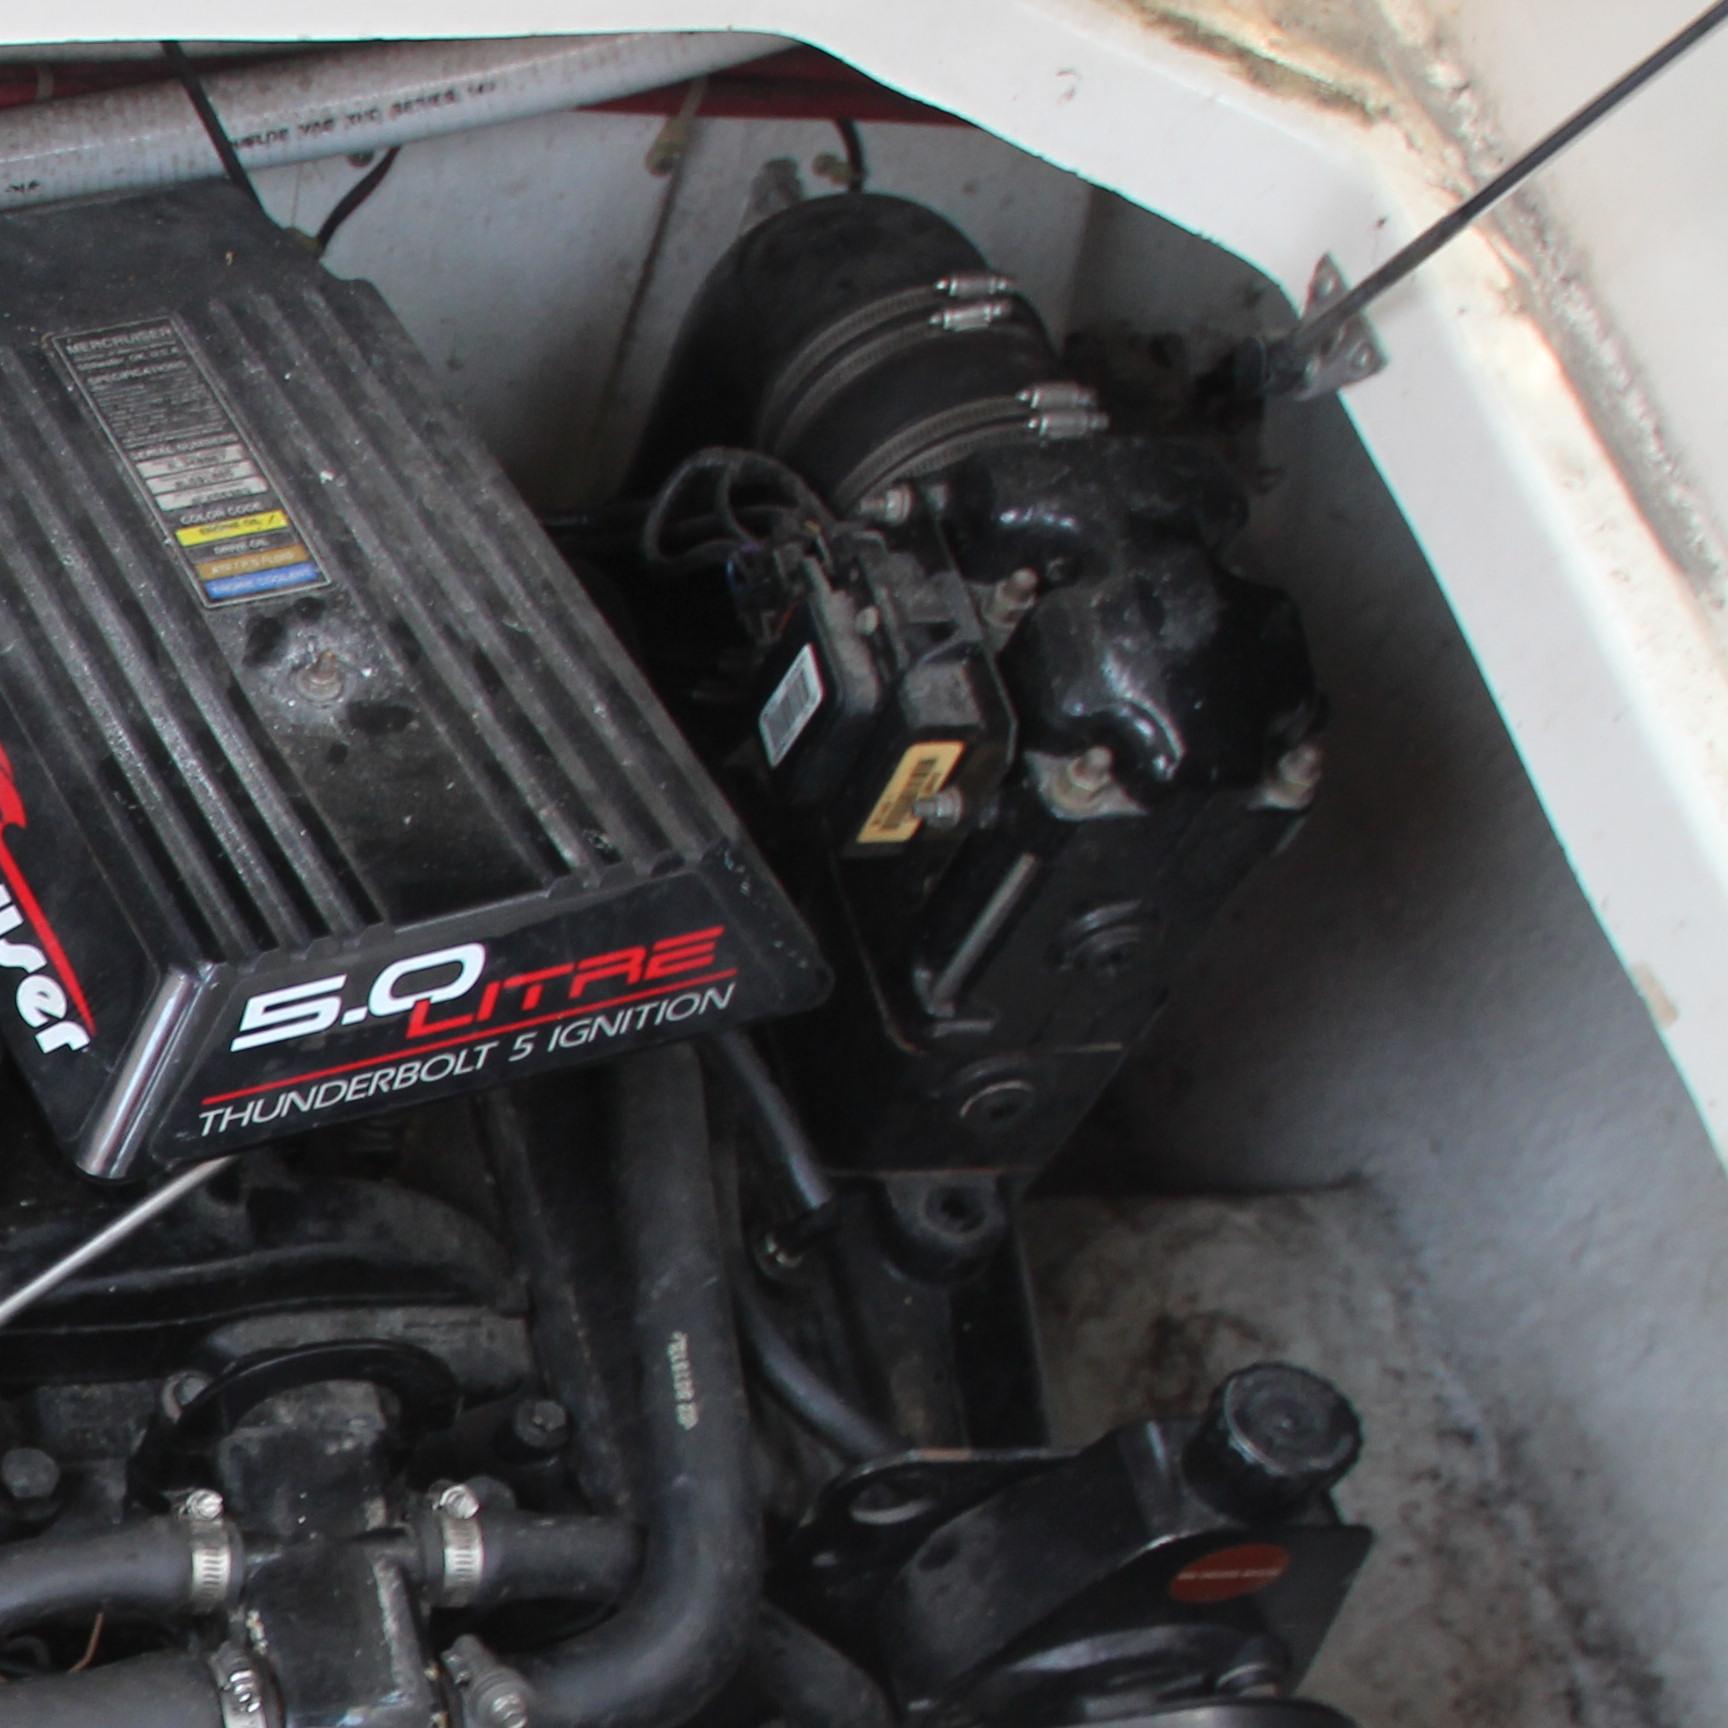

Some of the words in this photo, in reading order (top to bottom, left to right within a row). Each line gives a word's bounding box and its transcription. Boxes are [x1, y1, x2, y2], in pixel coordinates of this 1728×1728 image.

[66, 326, 173, 353] MERCRUISER
[180, 510, 225, 526] COLOR
[227, 501, 264, 517] CODE
[231, 942, 485, 1052] 5.0
[406, 925, 725, 1040] LITRE
[199, 1042, 497, 1137] THUNDERBOLT
[509, 1031, 537, 1063] 5
[548, 983, 736, 1053] IGNITION
